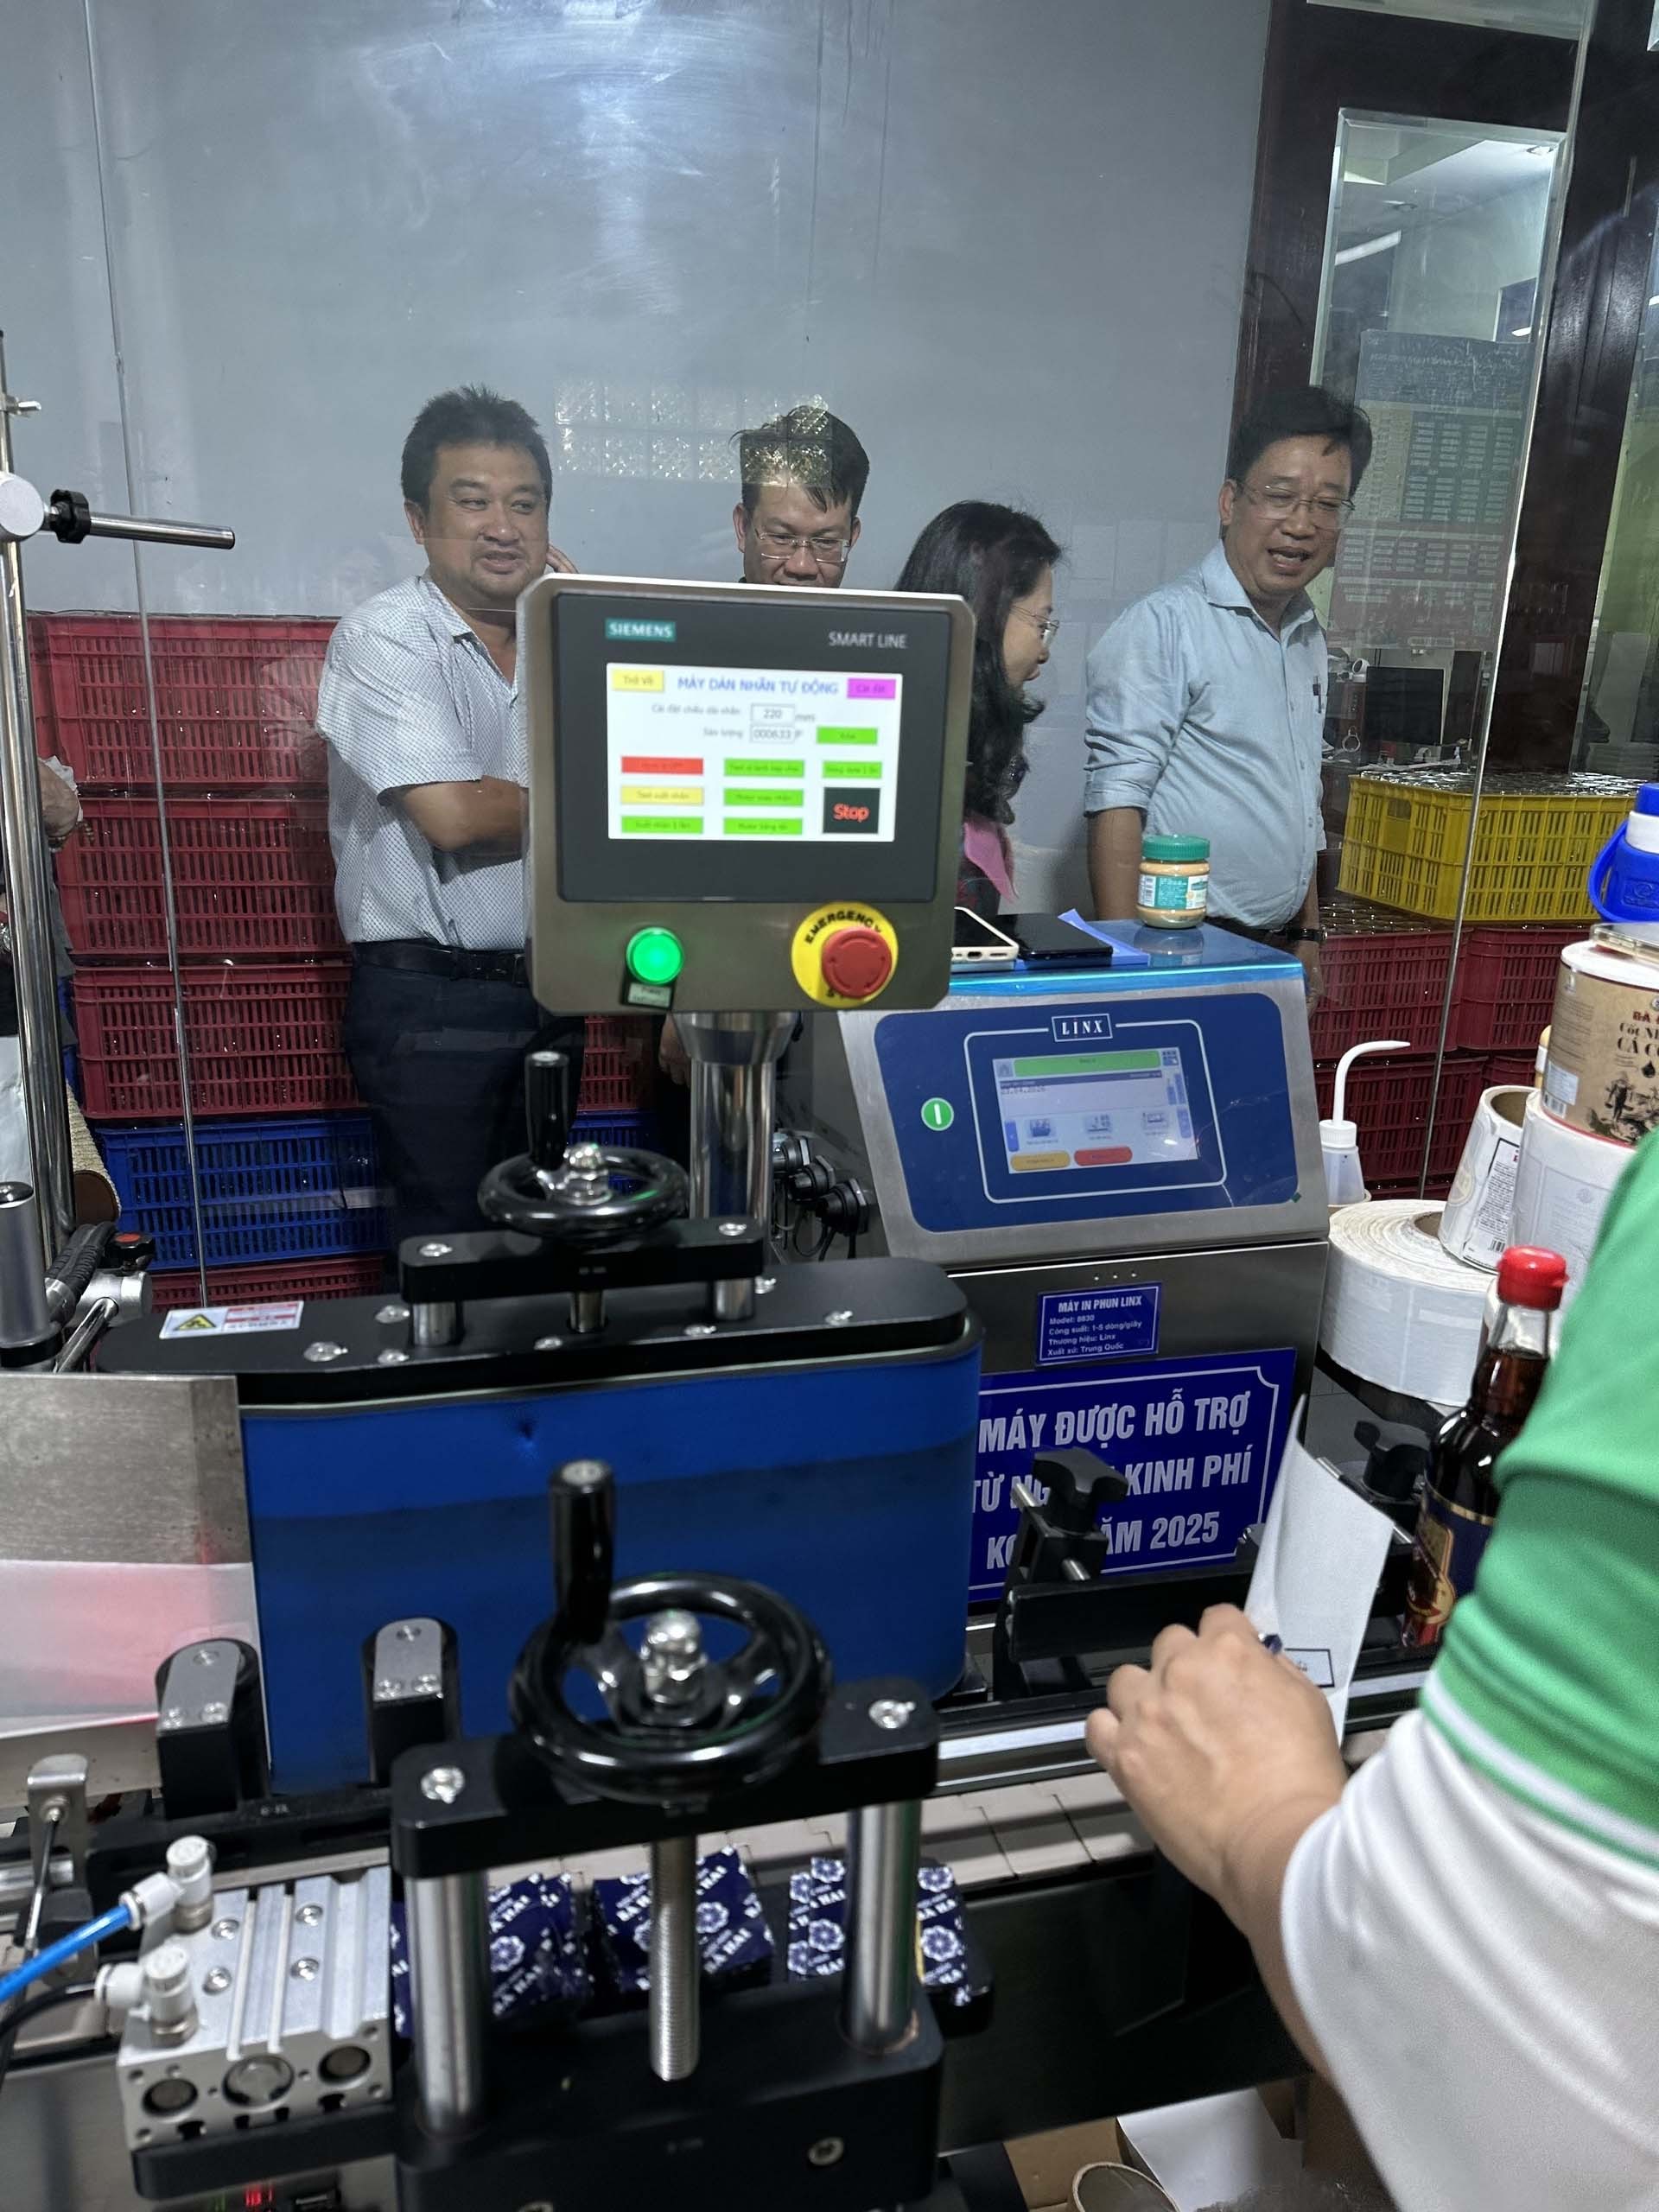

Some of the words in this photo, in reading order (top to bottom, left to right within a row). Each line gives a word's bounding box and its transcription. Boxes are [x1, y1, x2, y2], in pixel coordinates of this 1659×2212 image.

[608, 621, 673, 639] SIEMENS
[829, 631, 874, 647] SMART
[877, 633, 907, 649] LINE
[677, 675, 705, 690] MÁY
[763, 709, 784, 720] 220
[833, 802, 870, 823] Stop
[1062, 1020, 1103, 1035] LINX
[1058, 1299, 1080, 1313] MÁY
[1081, 1300, 1092, 1311] IN
[1093, 1297, 1119, 1310] PHUN
[1121, 1295, 1143, 1307] LINX
[1099, 1332, 1116, 1342] Linx
[1080, 1344, 1103, 1354] Trung
[978, 1408, 1046, 1453] MÁY
[1054, 1403, 1136, 1448] ĐƯỢC
[1144, 1388, 1185, 1437] HỖ
[1194, 1390, 1251, 1435] TRỢ
[972, 1471, 1005, 1513] TỪ
[1125, 1457, 1195, 1497] KINH
[1202, 1444, 1254, 1488] PHÍ
[1099, 1516, 1143, 1555] ĂM
[1149, 1511, 1221, 1550] 2025
